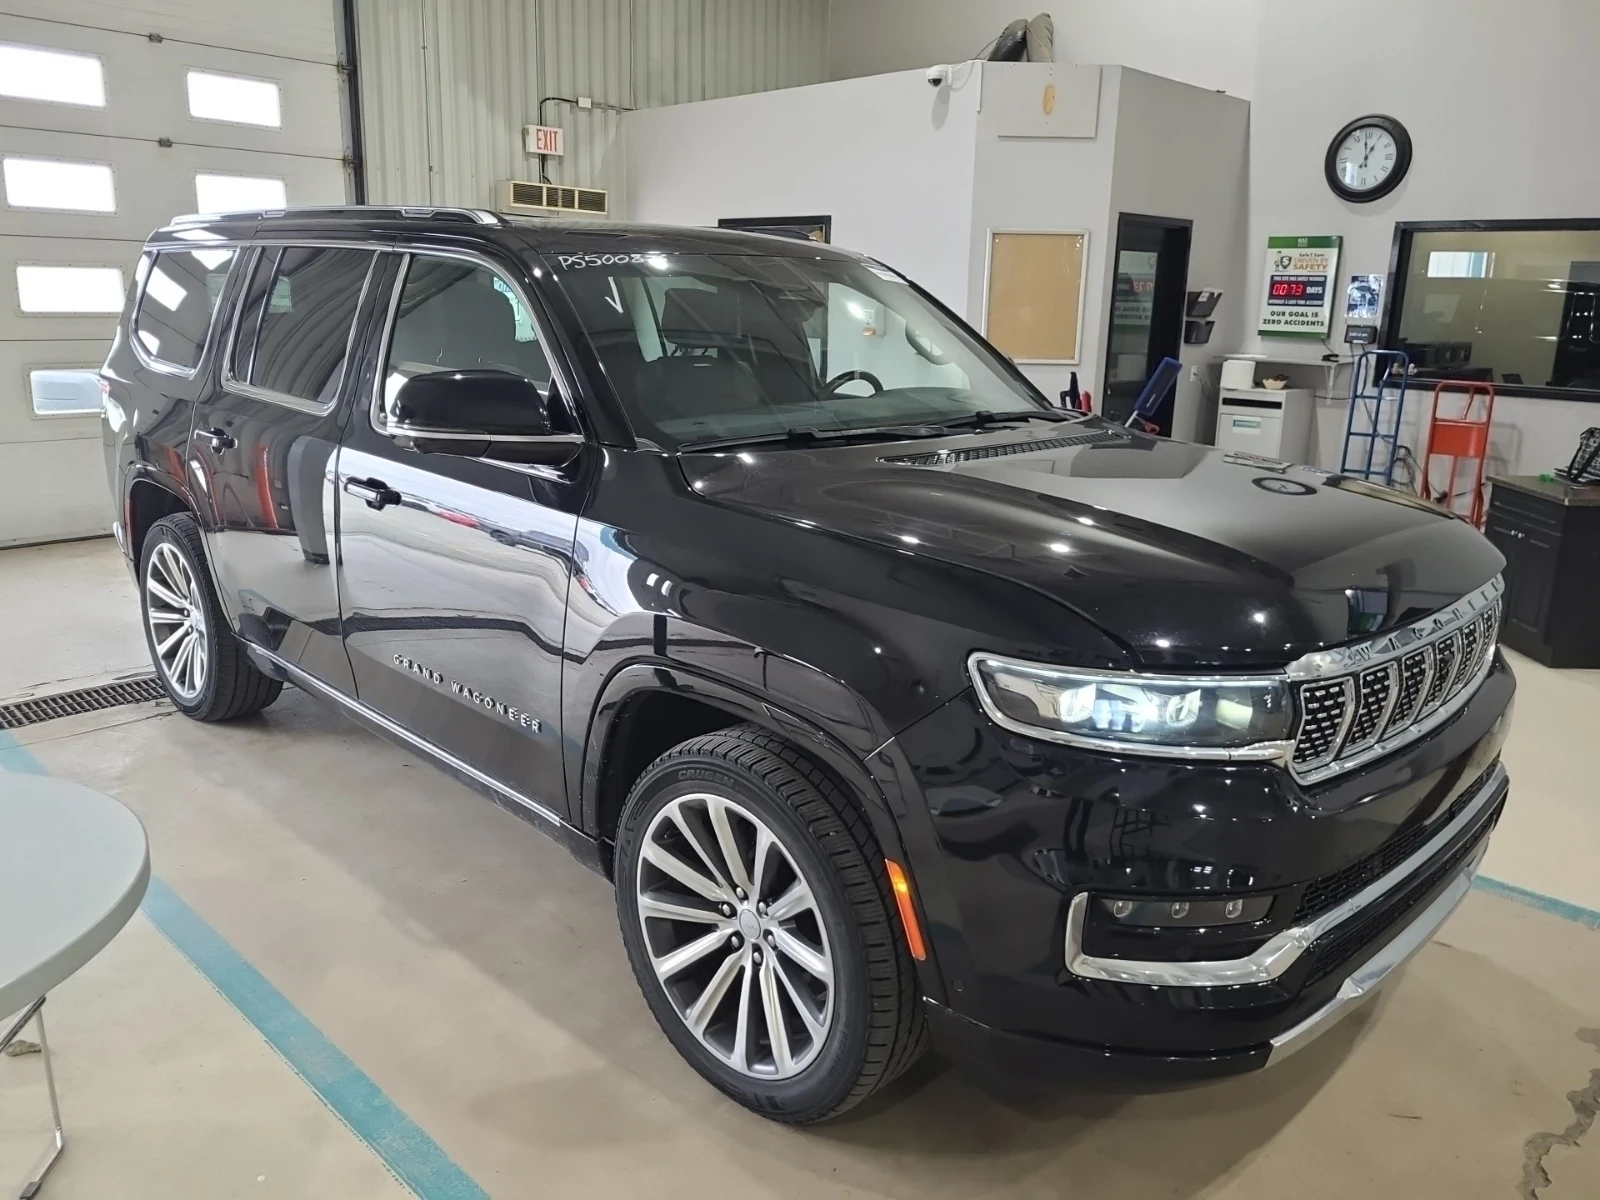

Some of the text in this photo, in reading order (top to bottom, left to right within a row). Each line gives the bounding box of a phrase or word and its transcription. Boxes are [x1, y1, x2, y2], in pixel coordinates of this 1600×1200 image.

[536, 128, 558, 152] EXIT
[1306, 286, 1323, 294] DAYS
[1283, 319, 1325, 327] ACCIDENTS
[393, 653, 542, 733] GRAND WAGONEER
[678, 769, 735, 788] CRUGEN
